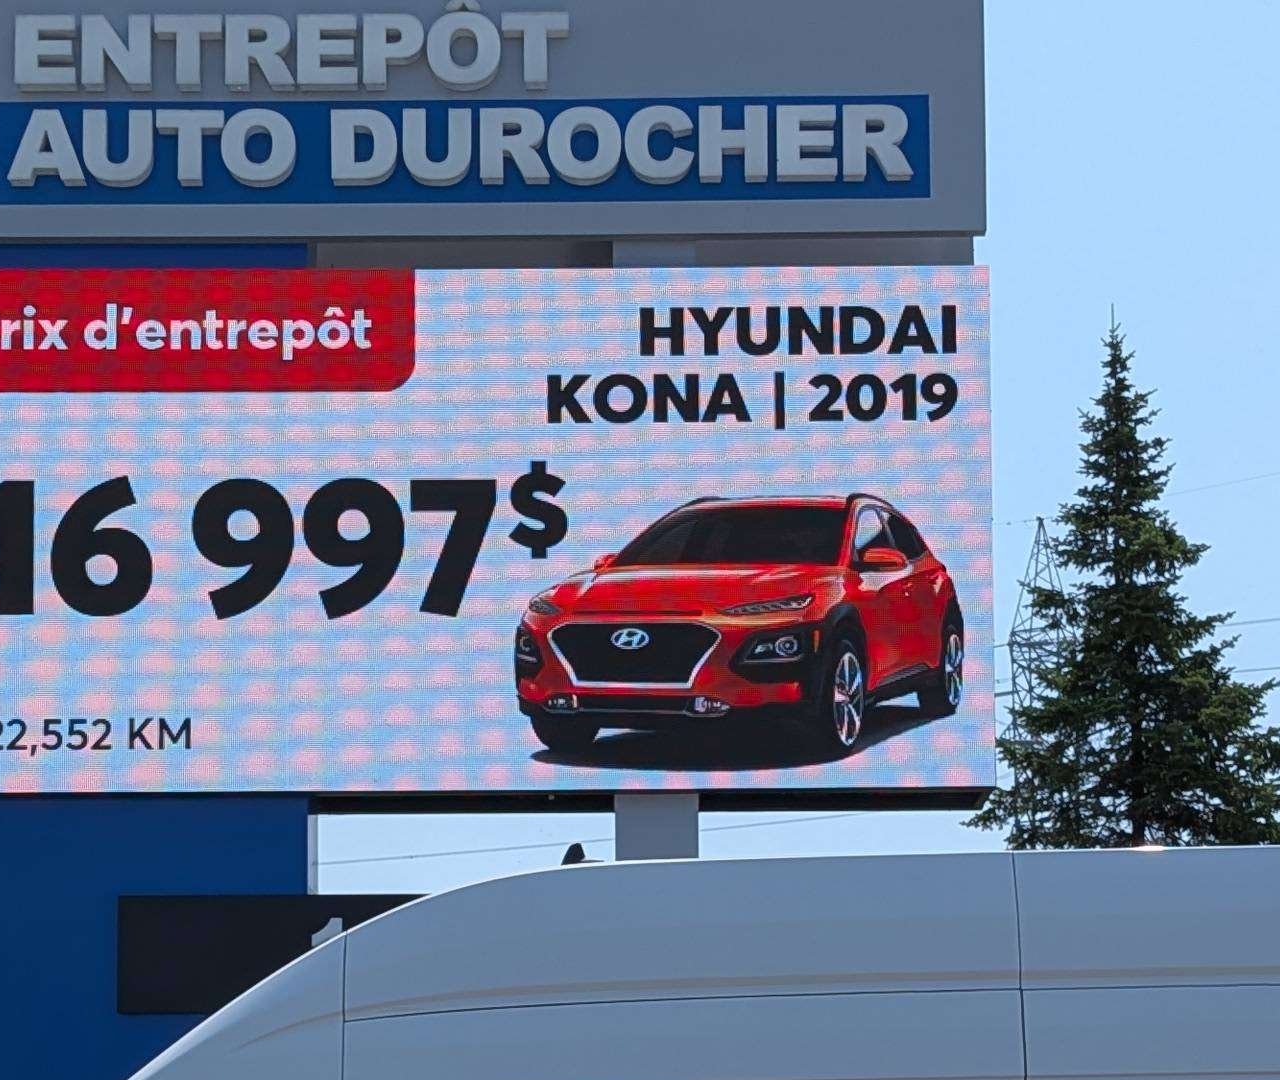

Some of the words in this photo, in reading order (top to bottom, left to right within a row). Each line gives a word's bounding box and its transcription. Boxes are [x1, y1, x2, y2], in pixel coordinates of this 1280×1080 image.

[14, 0, 570, 92] ENTREPÔT
[6, 107, 297, 188] AUTO
[330, 104, 914, 187] DUROCHER
[83, 303, 373, 361] d'entrepôt
[639, 304, 958, 357] HYUNDAI
[546, 372, 753, 424] KONA
[808, 372, 959, 423] 2019
[127, 717, 192, 751] KM
